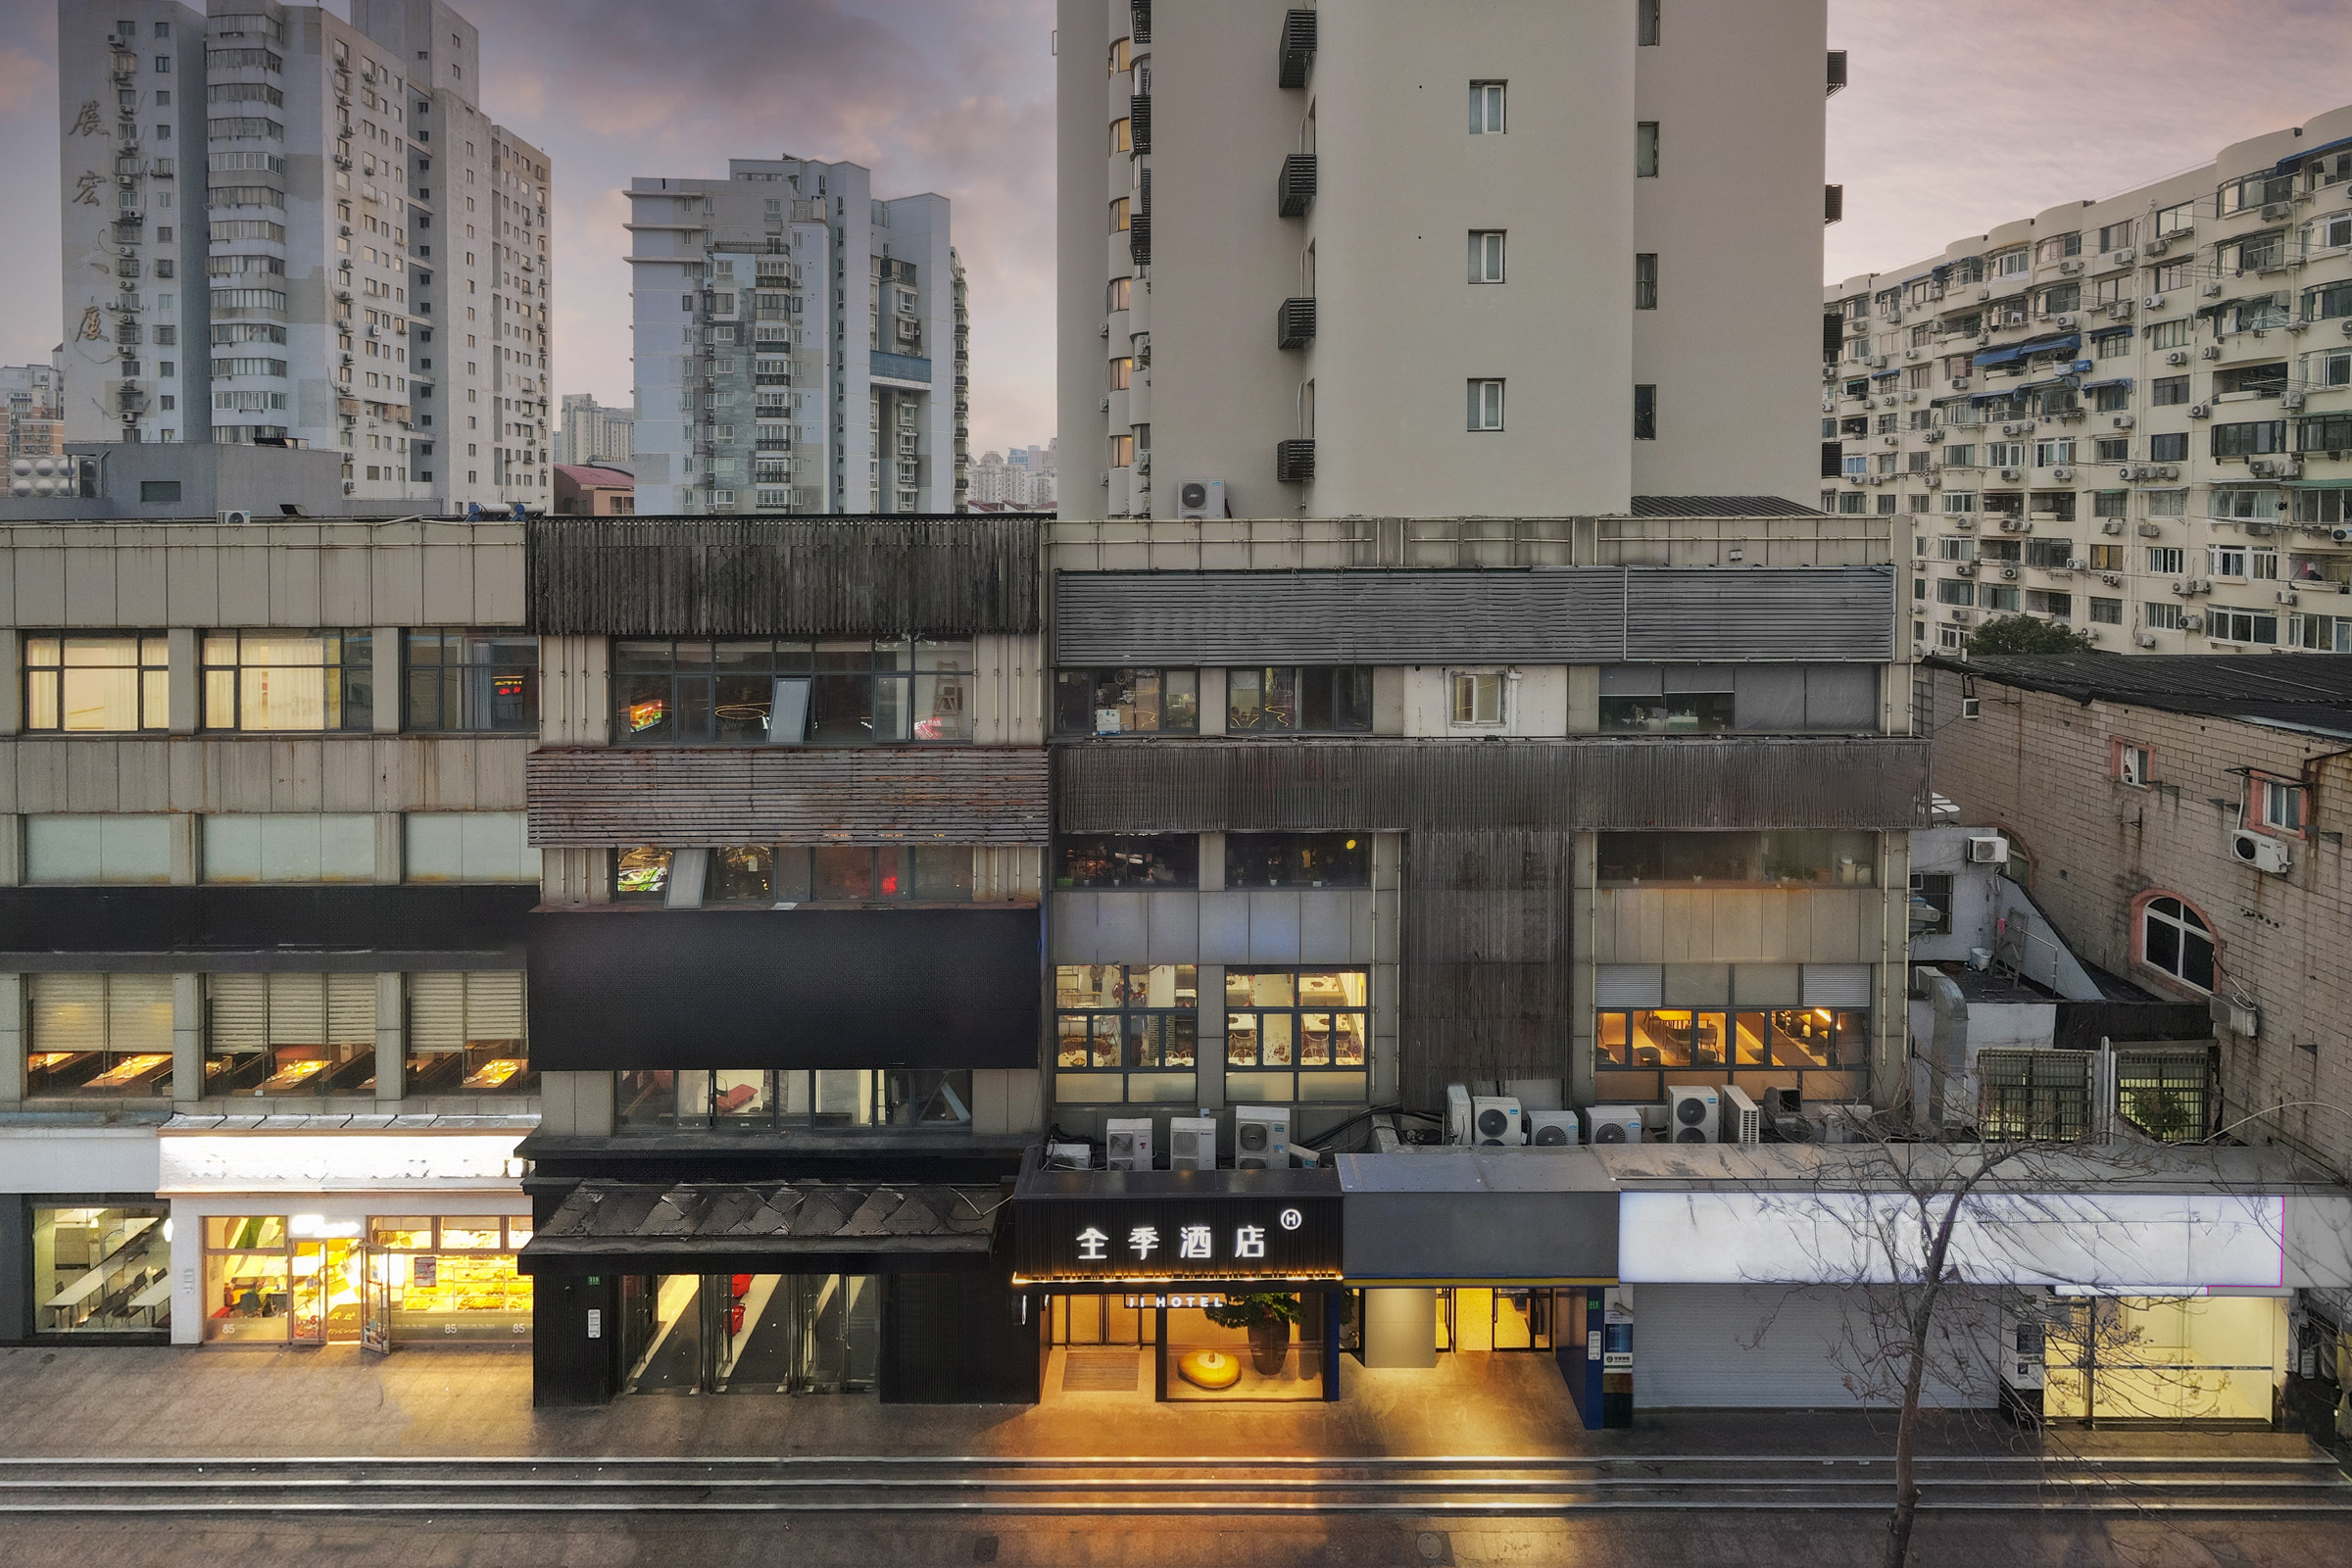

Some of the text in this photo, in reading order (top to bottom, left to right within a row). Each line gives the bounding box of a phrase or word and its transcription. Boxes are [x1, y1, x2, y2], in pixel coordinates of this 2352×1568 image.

[1076, 1225, 1266, 1260] 全季酒店
[1155, 1296, 1224, 1308] HOTEL
[221, 1323, 235, 1334] 85
[444, 1323, 458, 1334] 85
[512, 1323, 525, 1334] 85
